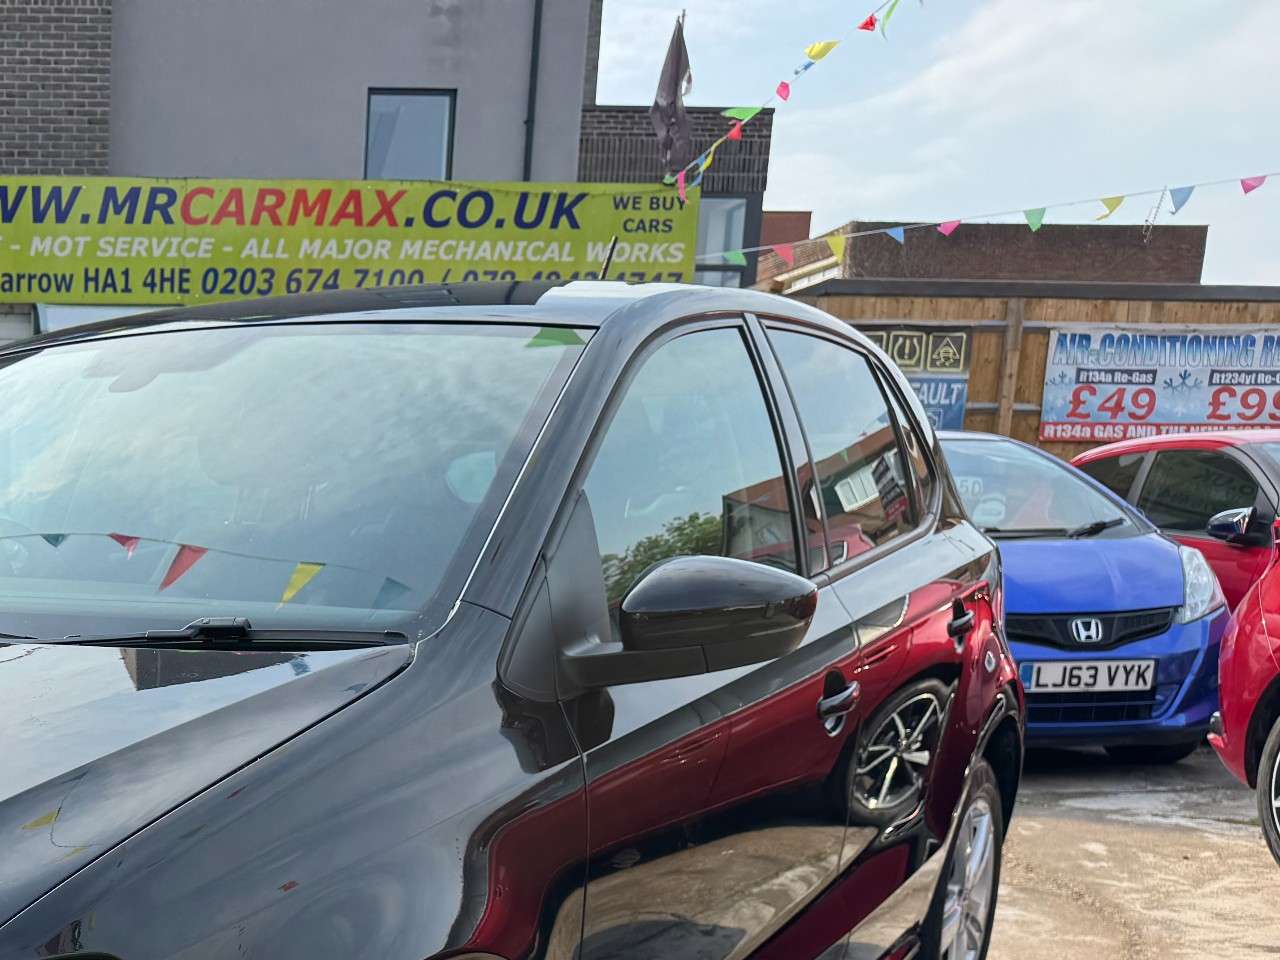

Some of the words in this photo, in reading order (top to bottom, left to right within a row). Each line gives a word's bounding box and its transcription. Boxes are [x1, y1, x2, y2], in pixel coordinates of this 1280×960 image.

[613, 195, 642, 210] WE
[649, 196, 686, 210] BUY
[623, 218, 673, 233] CARS
[30, 237, 91, 258] MOT
[96, 237, 214, 259] SERVICE
[240, 239, 287, 259] ALL
[304, 239, 392, 261] MAJOR
[398, 240, 575, 262] MECHANICAL
[584, 242, 685, 263] WORKS
[83, 268, 132, 294] HA1
[142, 268, 191, 294] 4HE
[201, 267, 276, 295] 0203
[285, 268, 341, 294] 674
[1066, 384, 1157, 420] £49
[1043, 424, 1090, 438] R134a
[1094, 425, 1123, 438] GAS
[1126, 425, 1156, 438] AND
[1034, 665, 1098, 687] LJ63
[1106, 664, 1151, 686] VYK
